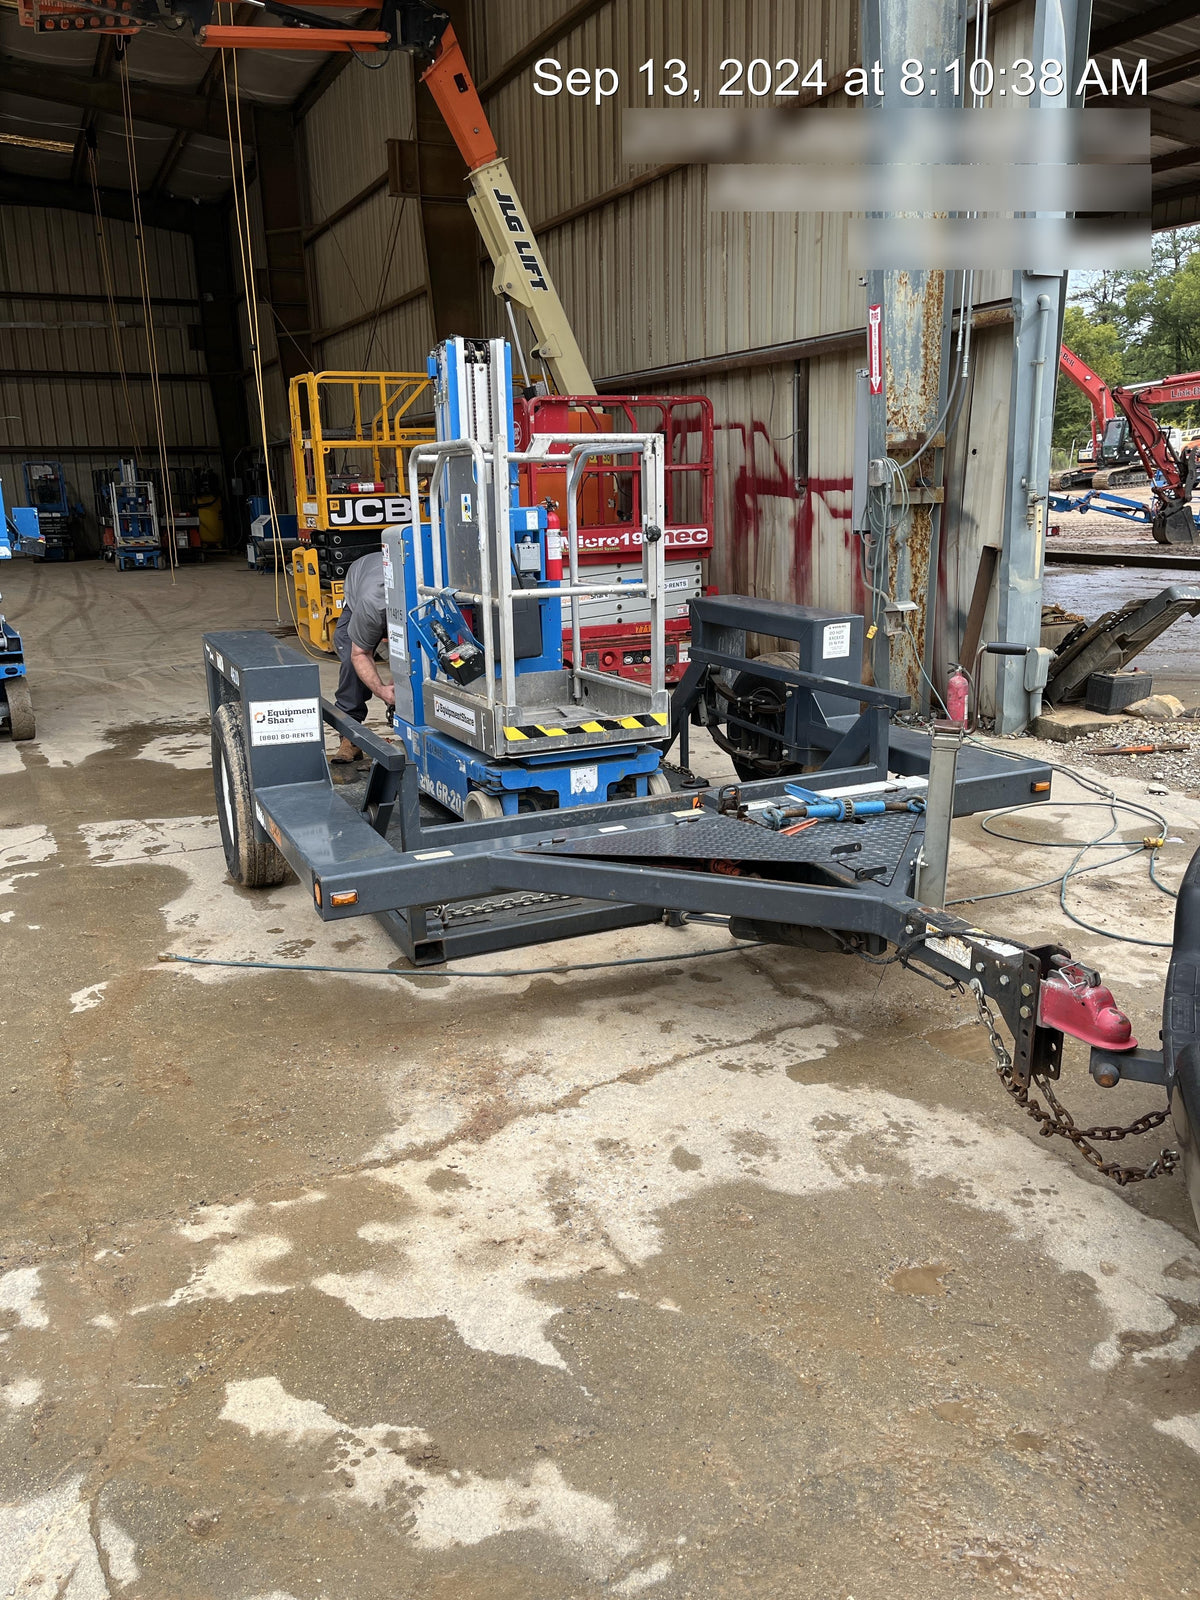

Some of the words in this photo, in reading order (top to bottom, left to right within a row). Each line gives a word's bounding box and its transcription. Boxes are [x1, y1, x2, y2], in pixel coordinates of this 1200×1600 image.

[493, 188, 525, 232] JLG
[513, 240, 549, 292] LIFT
[330, 498, 413, 524] JCB
[664, 580, 687, 590] 0-RENTS
[267, 707, 316, 718] Equipment
[267, 717, 294, 725] Share
